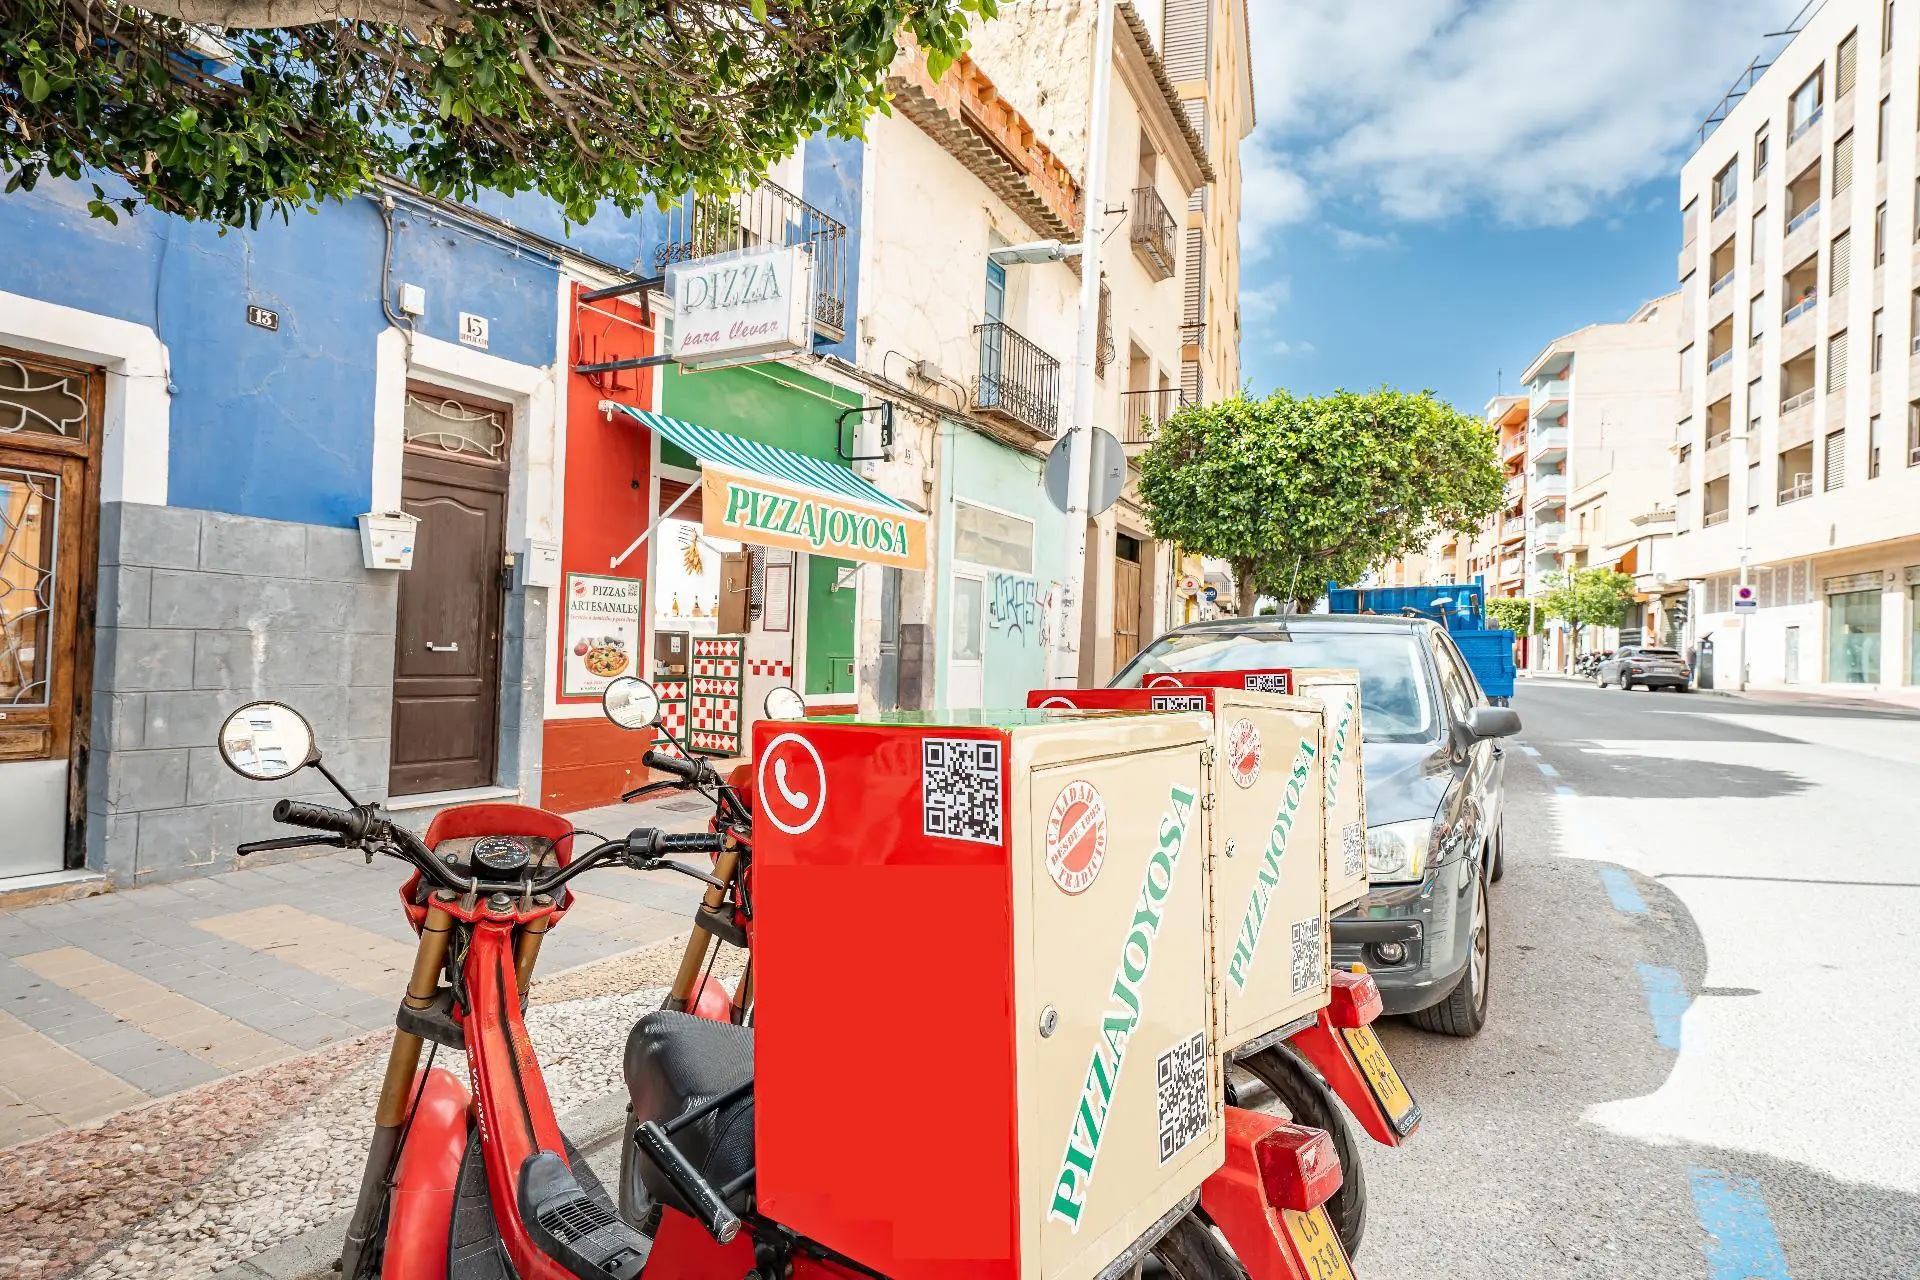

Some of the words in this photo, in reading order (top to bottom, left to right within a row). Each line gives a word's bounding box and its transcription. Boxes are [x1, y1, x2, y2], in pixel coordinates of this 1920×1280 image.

[255, 309, 272, 325] 13
[680, 330, 720, 350] para
[729, 320, 779, 340] llevar
[725, 486, 908, 555] PIZZAJOYOSA
[570, 600, 638, 614] ARTESANALES
[592, 585, 626, 598] PIZZAS
[1048, 785, 1095, 846] CALIDAD
[1051, 828, 1079, 866] DESDE
[1229, 739, 1316, 989] PIZZAJOYOSA
[1050, 783, 1195, 1227] PIZZAJOYOSA
[1298, 1211, 1320, 1243] C6
